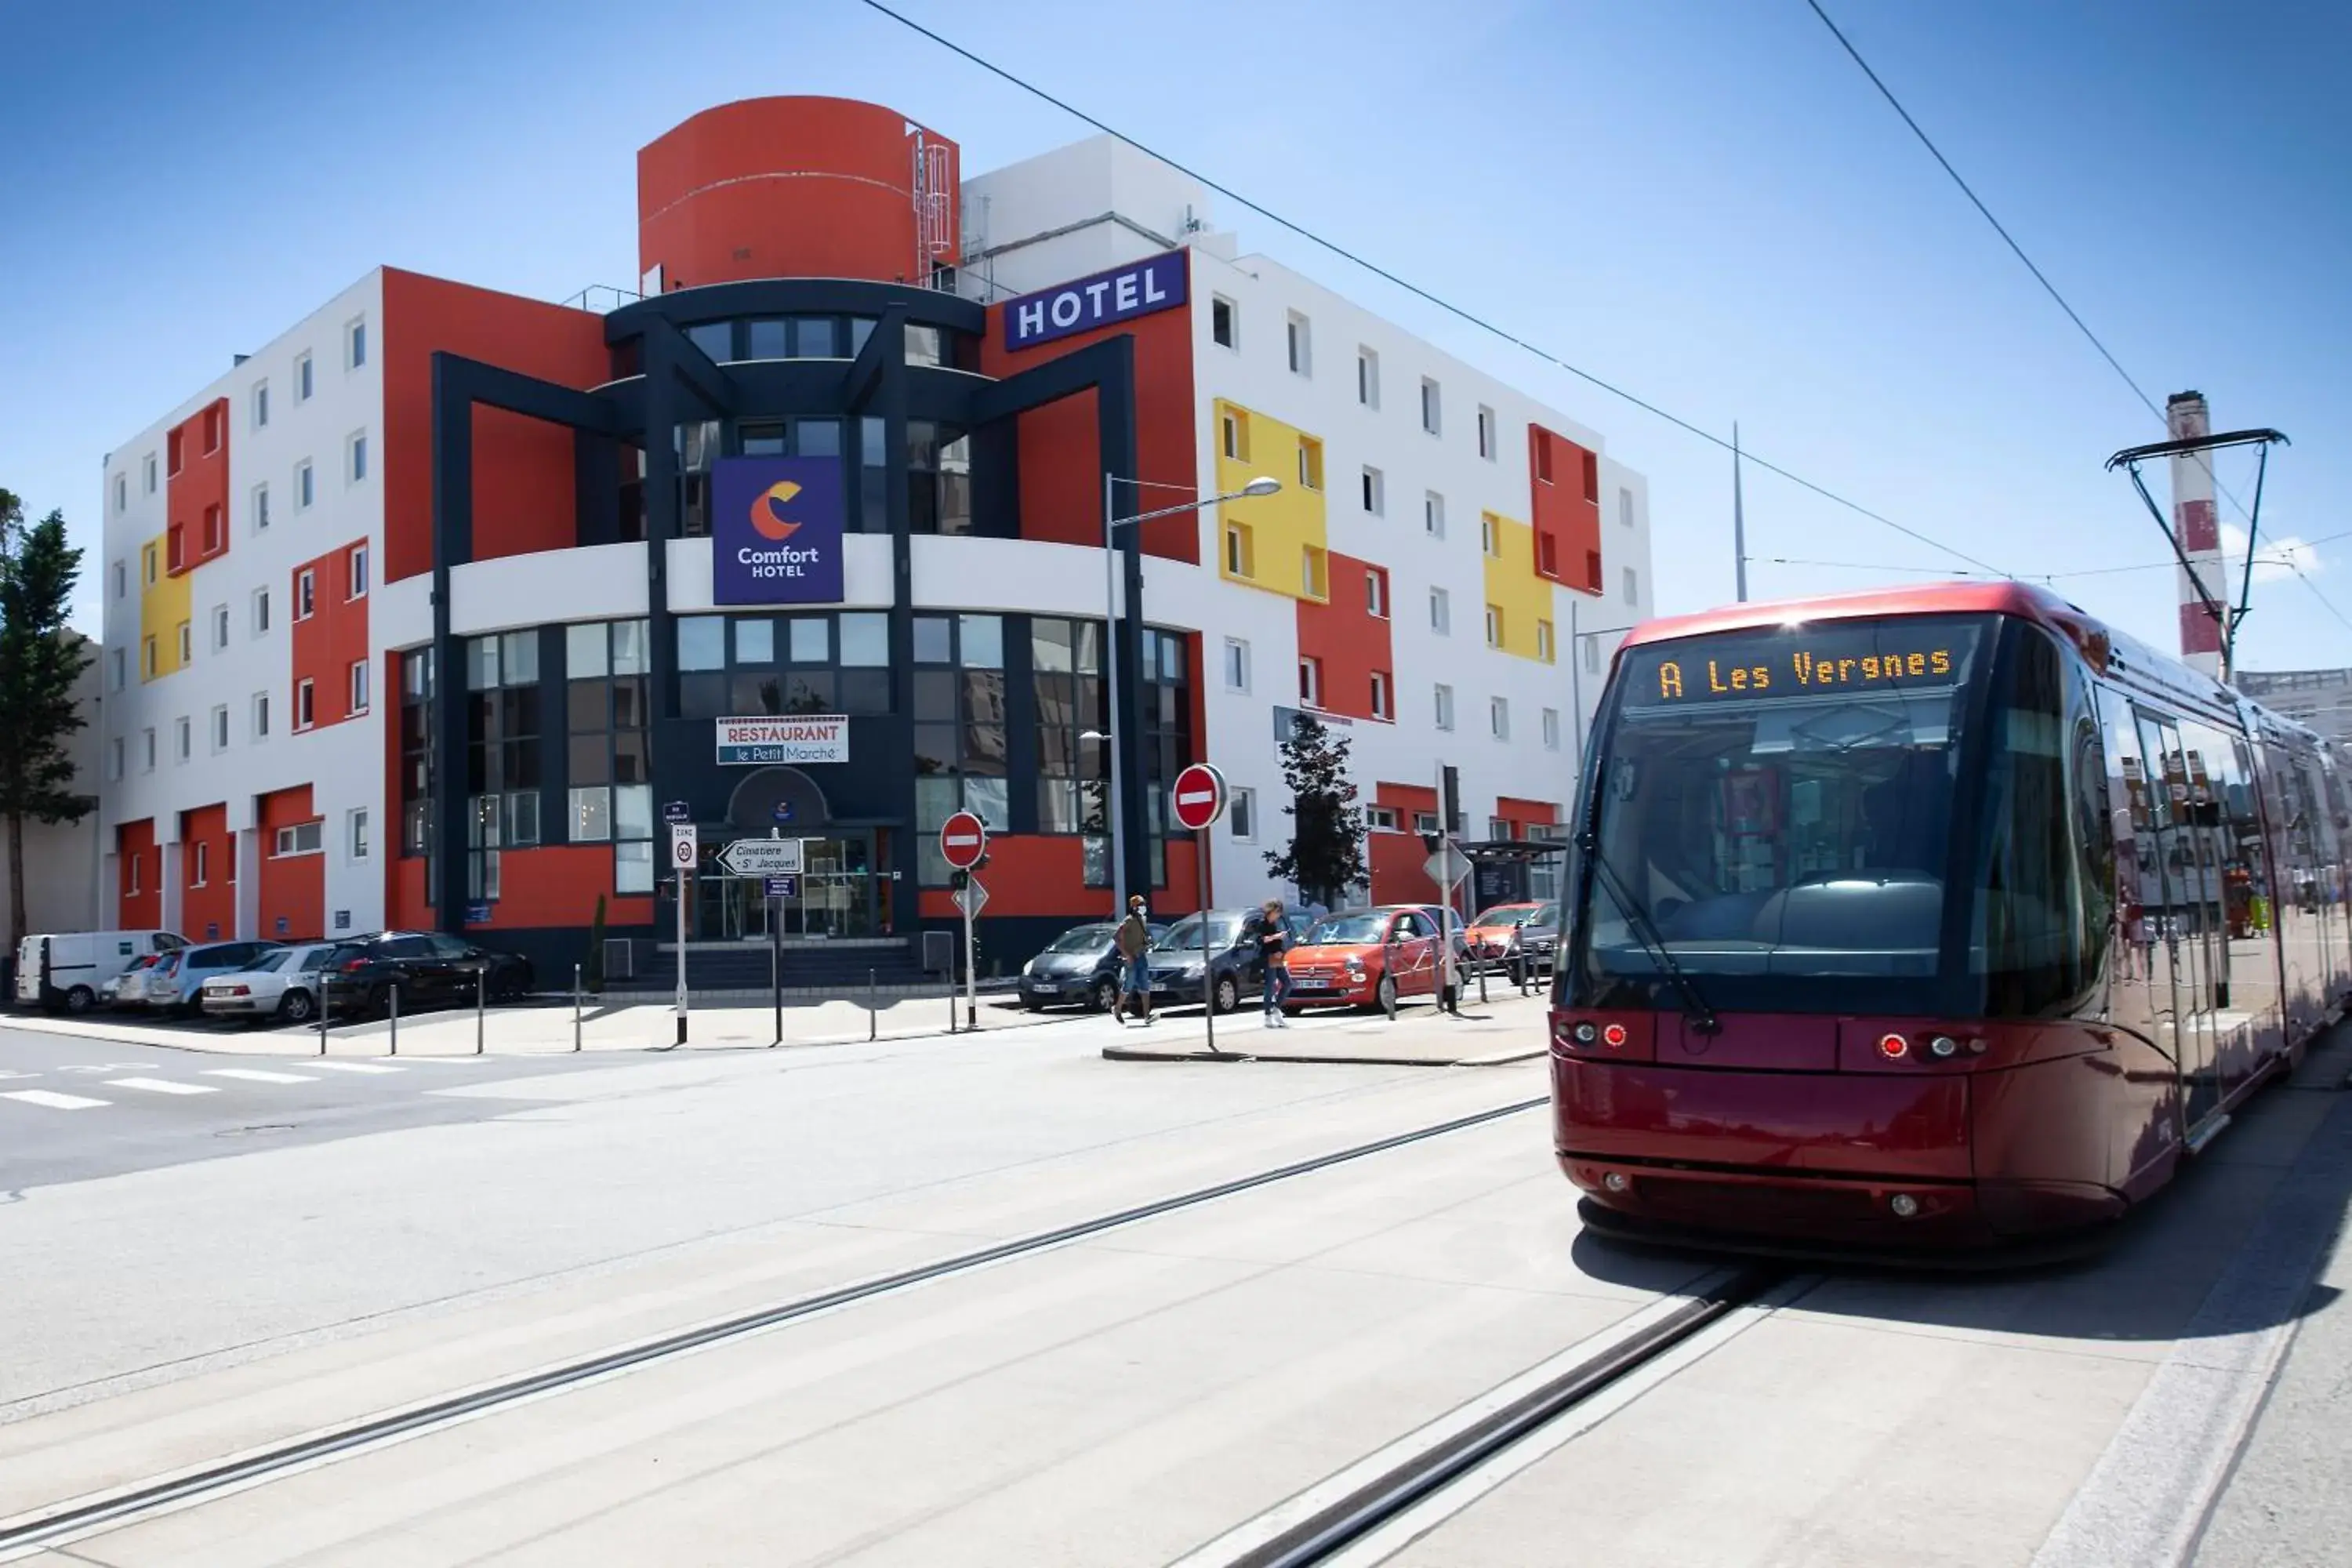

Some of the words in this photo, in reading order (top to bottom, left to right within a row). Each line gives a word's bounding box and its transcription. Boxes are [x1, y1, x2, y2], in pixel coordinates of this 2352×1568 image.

[1018, 267, 1166, 339] HOTEL
[738, 546, 819, 564] Comfort
[752, 565, 805, 577] HOTEL
[1660, 662, 1682, 698] A
[1709, 661, 1769, 691] Les
[1793, 650, 1951, 684] Vergnes
[728, 726, 839, 742] RESTAURANT
[753, 747, 781, 760] Petit
[757, 858, 796, 870] Jacques
